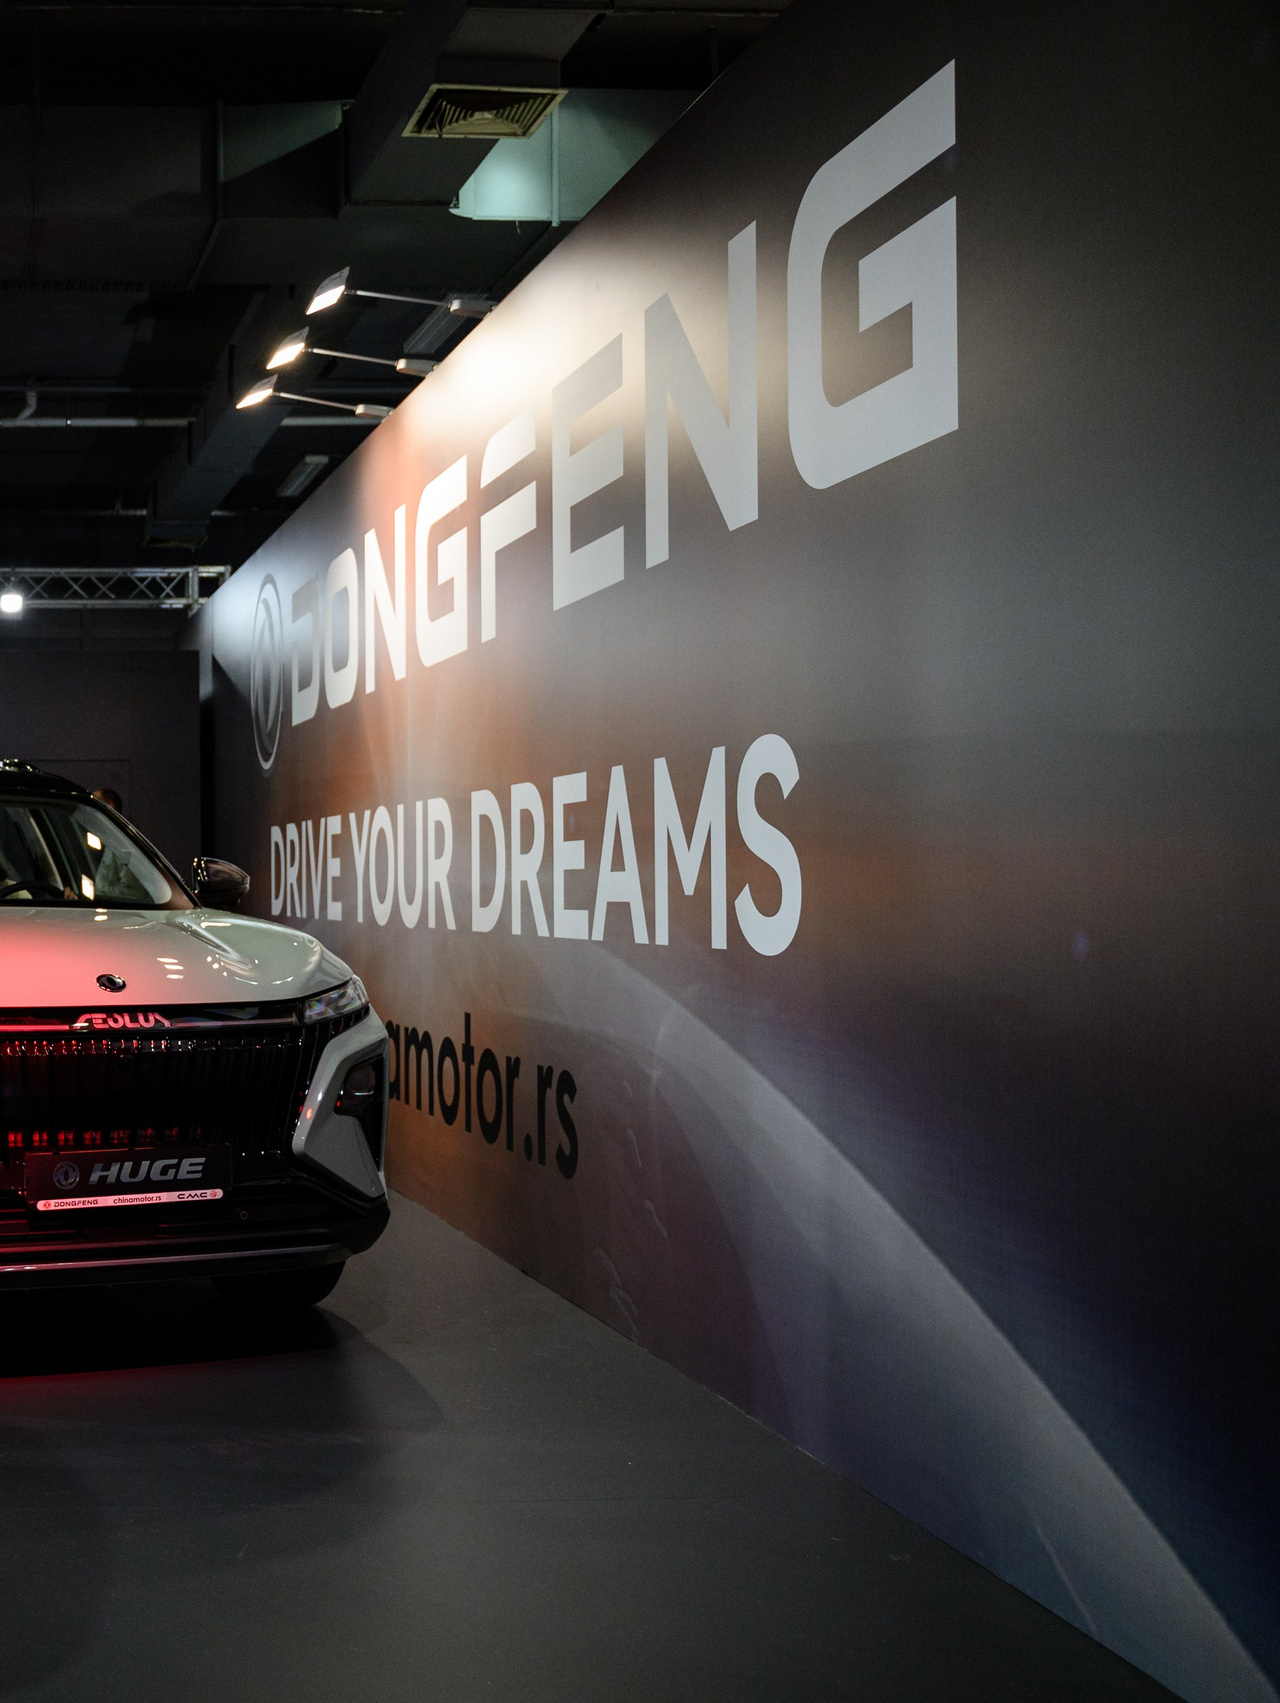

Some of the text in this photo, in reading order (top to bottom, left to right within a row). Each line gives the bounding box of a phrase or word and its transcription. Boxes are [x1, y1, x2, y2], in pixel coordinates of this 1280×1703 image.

[291, 58, 959, 727] DONGFENG
[270, 733, 803, 957] DRIVE YOUR DREAMS
[88, 1157, 206, 1185] HUGE
[387, 1012, 579, 1180] amotor.rs
[53, 1199, 99, 1208] DONGFENG
[113, 1194, 162, 1205] chinamotor.rs
